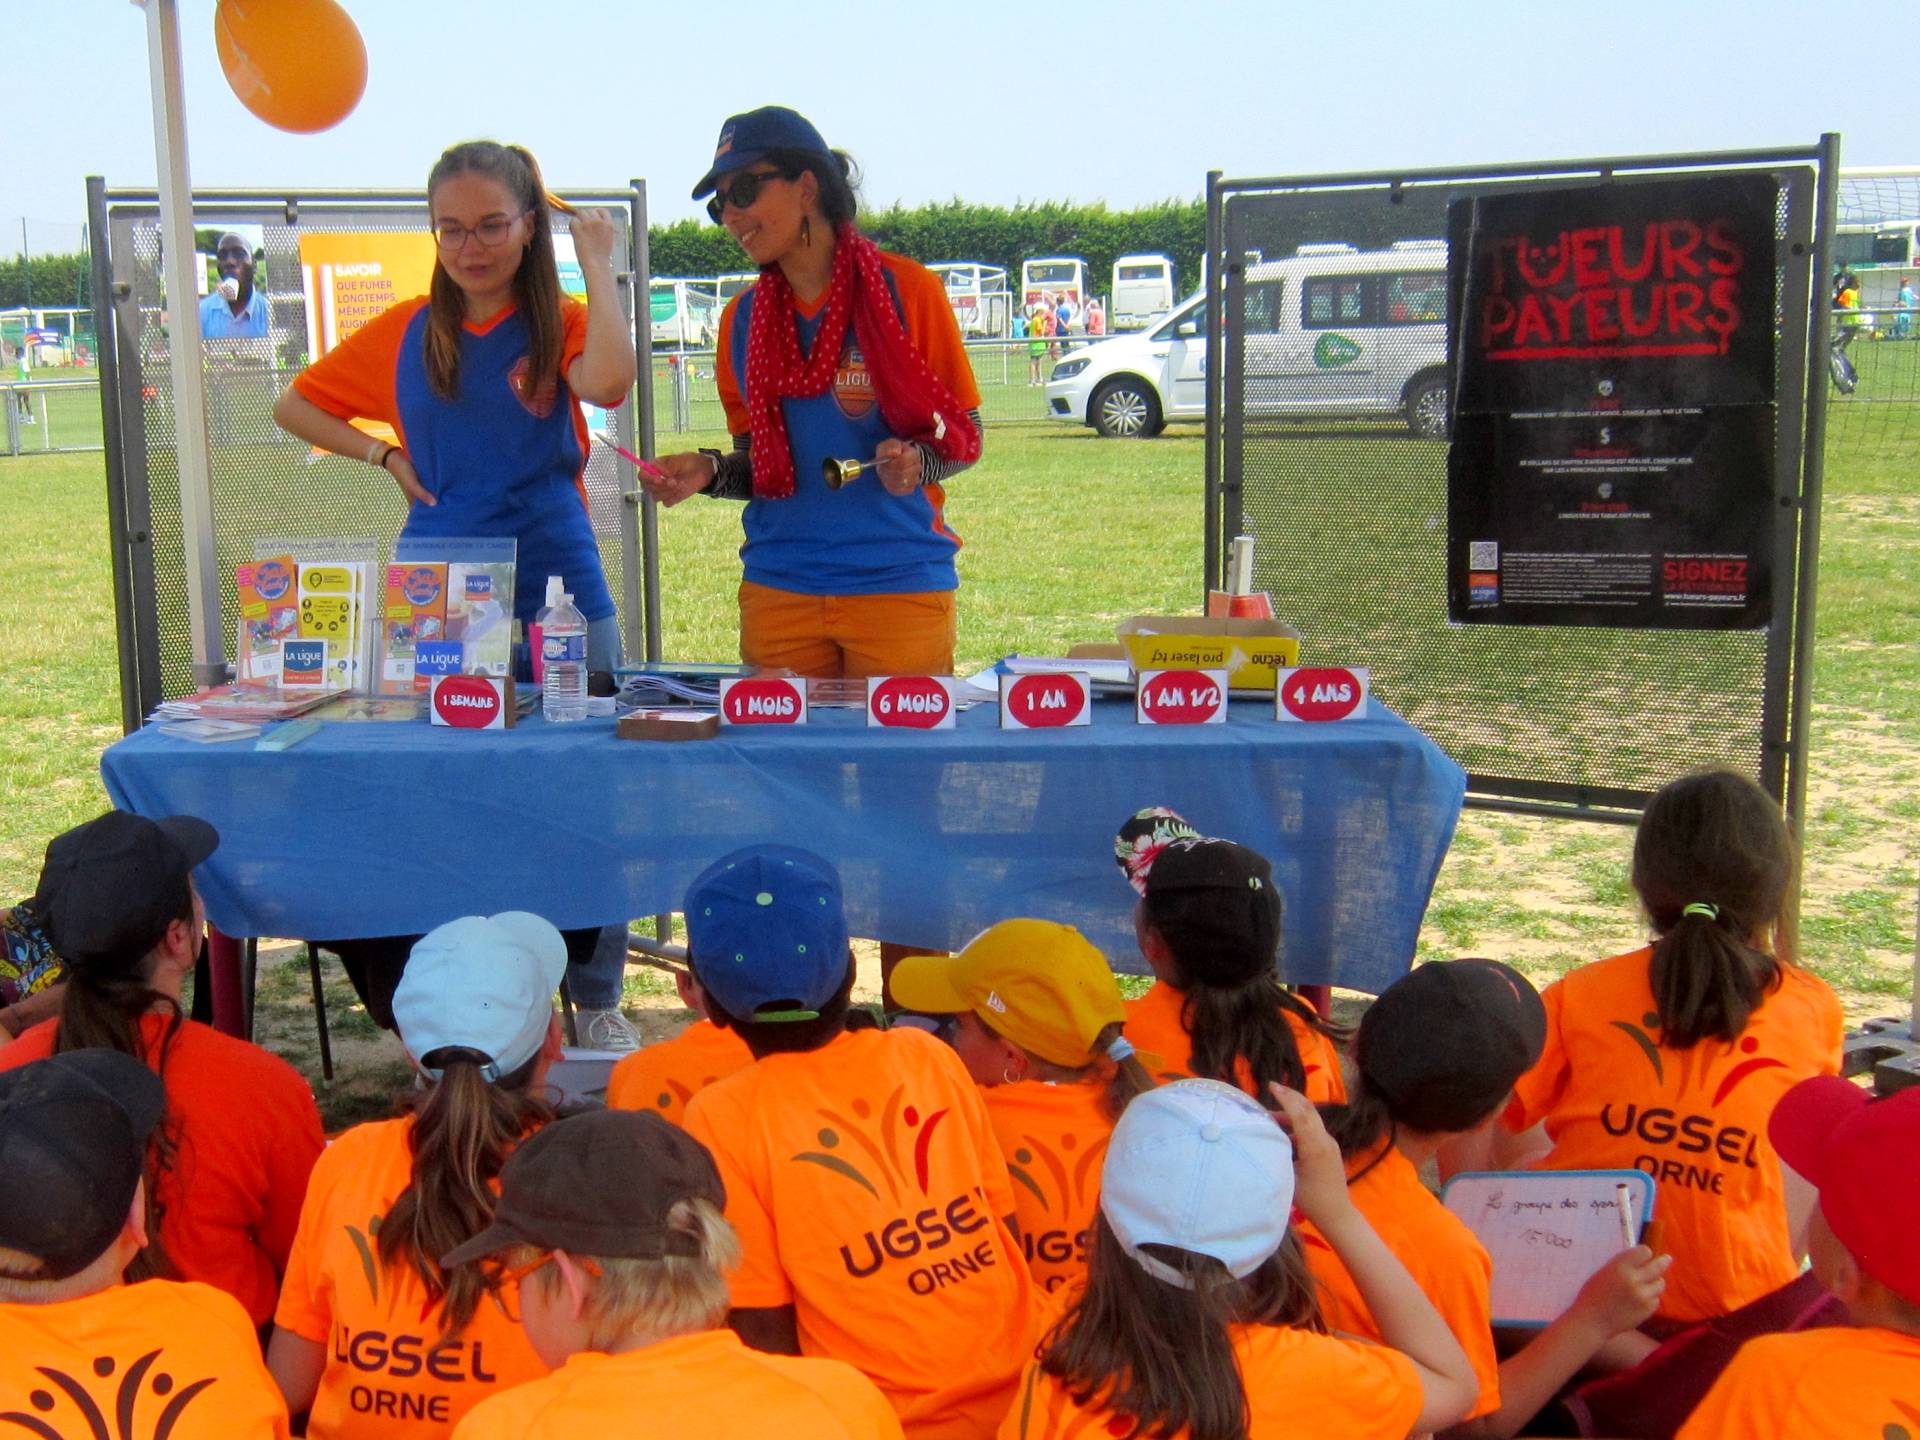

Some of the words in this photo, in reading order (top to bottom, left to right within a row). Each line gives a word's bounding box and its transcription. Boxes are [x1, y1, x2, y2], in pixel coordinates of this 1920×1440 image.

[1486, 219, 1744, 288] TUEURS
[335, 263, 382, 277] SAVOIR
[336, 281, 357, 290] QUE
[360, 280, 392, 290] FUMER
[337, 293, 398, 303] LONGTEMPS,
[1483, 278, 1740, 350] PAYEURS
[339, 320, 369, 329] AUGM
[836, 373, 870, 386] LIGU
[1664, 561, 1747, 581] SIGNEZ
[286, 652, 296, 660] LA
[416, 654, 428, 664] LA
[1171, 653, 1200, 665] laser
[1203, 651, 1223, 663] pro
[1252, 654, 1286, 666] tecno
[443, 694, 448, 706] 1
[450, 694, 494, 708] SEMAINE
[879, 694, 891, 714] 6
[897, 692, 944, 714] MOIS
[1027, 692, 1034, 711] 1
[1040, 689, 1067, 709] AN
[1143, 690, 1151, 709] 1
[1157, 687, 1185, 707] AN
[1190, 687, 1220, 708] 1/2
[1293, 685, 1306, 704] 4
[1311, 682, 1352, 703] ANS
[734, 696, 742, 716] 1
[748, 696, 794, 716] MOIS
[1601, 1103, 1758, 1169] UGSEL
[1634, 1154, 1724, 1196] ORNE
[908, 1240, 996, 1296] ORNE
[336, 1325, 496, 1383] UGSEL
[350, 1385, 449, 1423] ORNE
